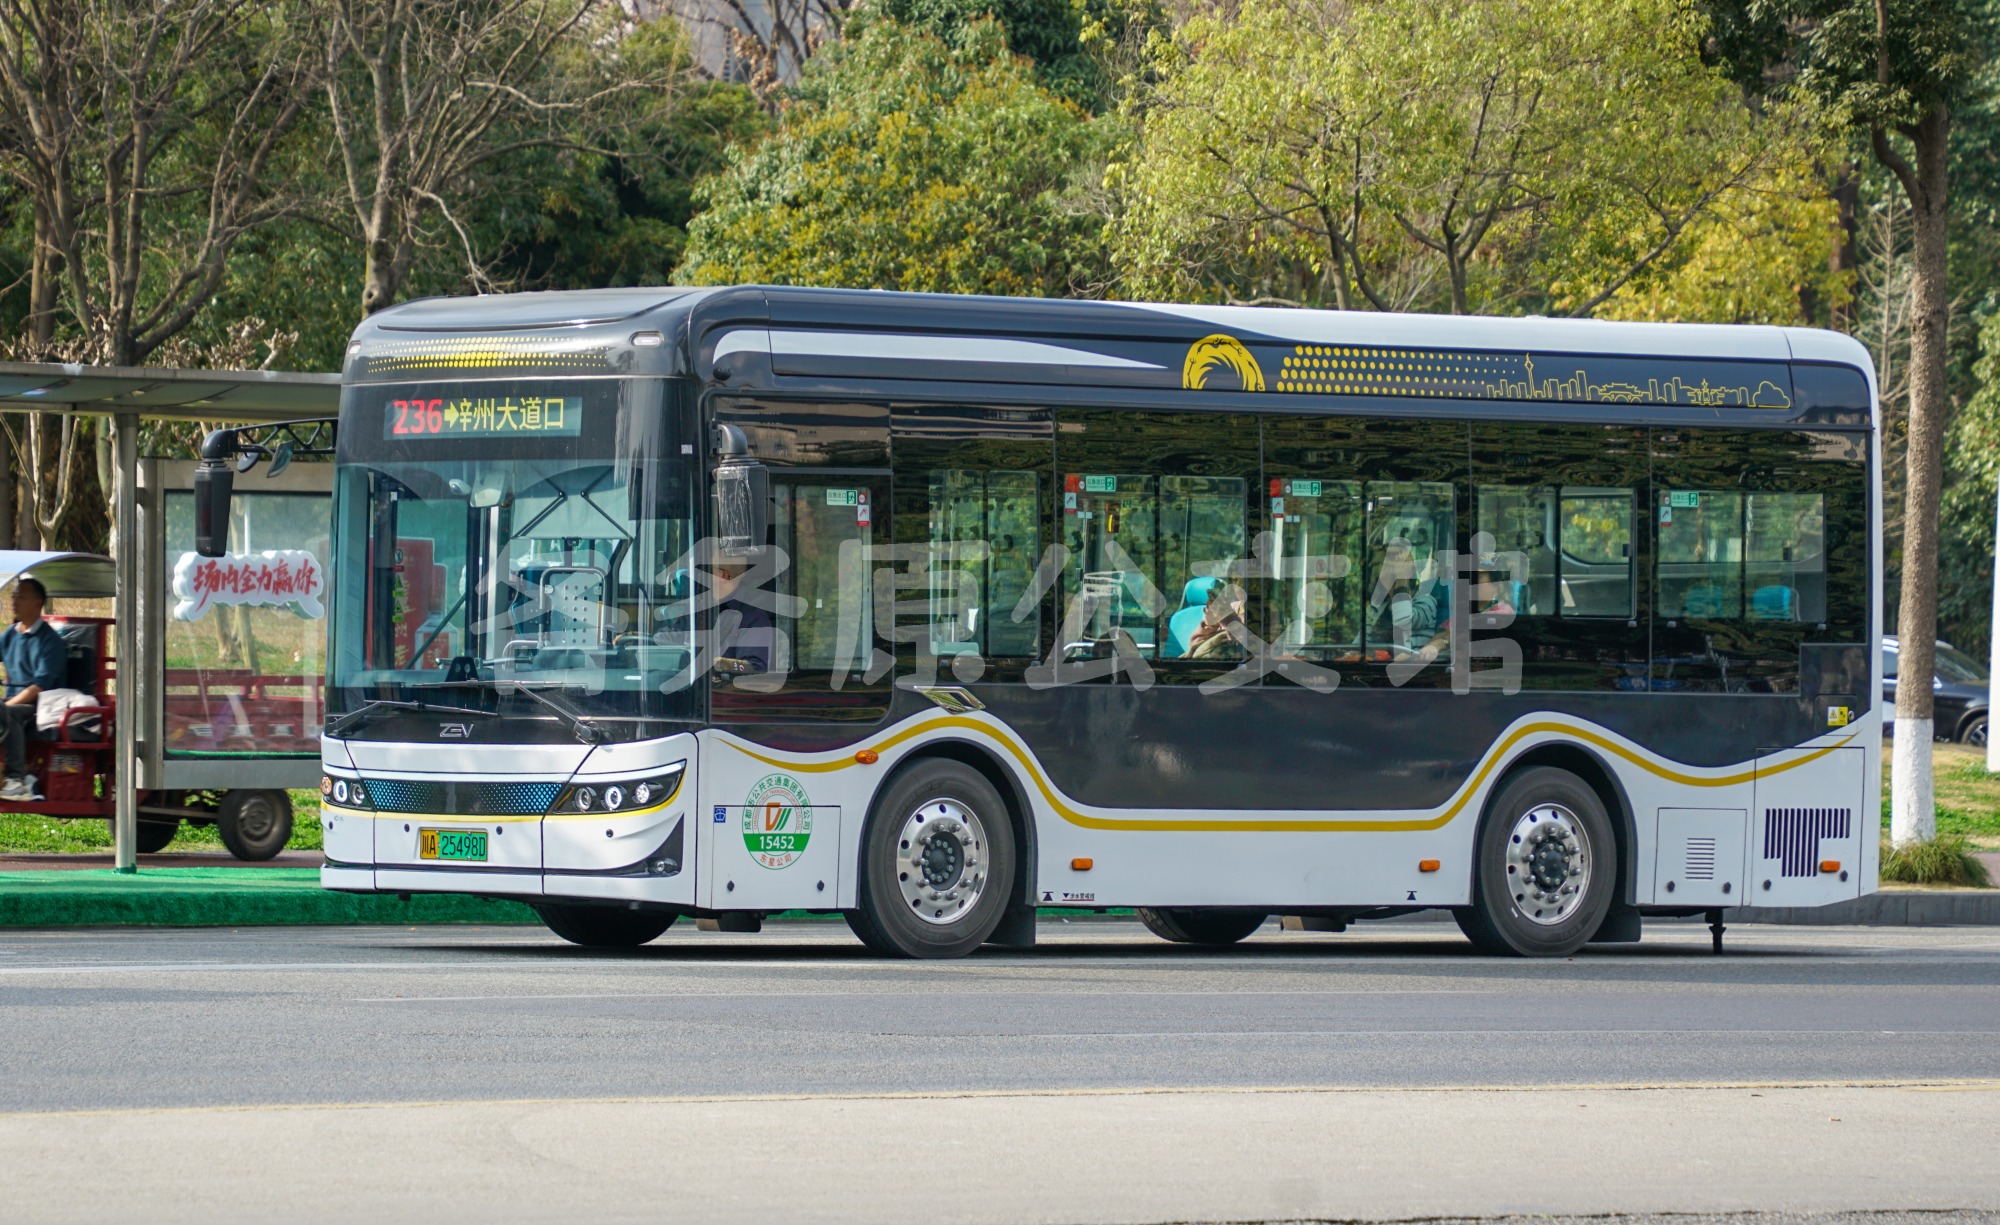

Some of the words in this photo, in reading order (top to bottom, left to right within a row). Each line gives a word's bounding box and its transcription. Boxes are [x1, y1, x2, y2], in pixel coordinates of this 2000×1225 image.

[393, 398, 443, 435] 236
[193, 558, 318, 613] 场内全力赢你
[439, 722, 474, 738] ZEV
[743, 776, 811, 830] 成都市公共交通集团有限公司
[759, 835, 795, 850] 15452
[760, 853, 792, 867] 东星公司
